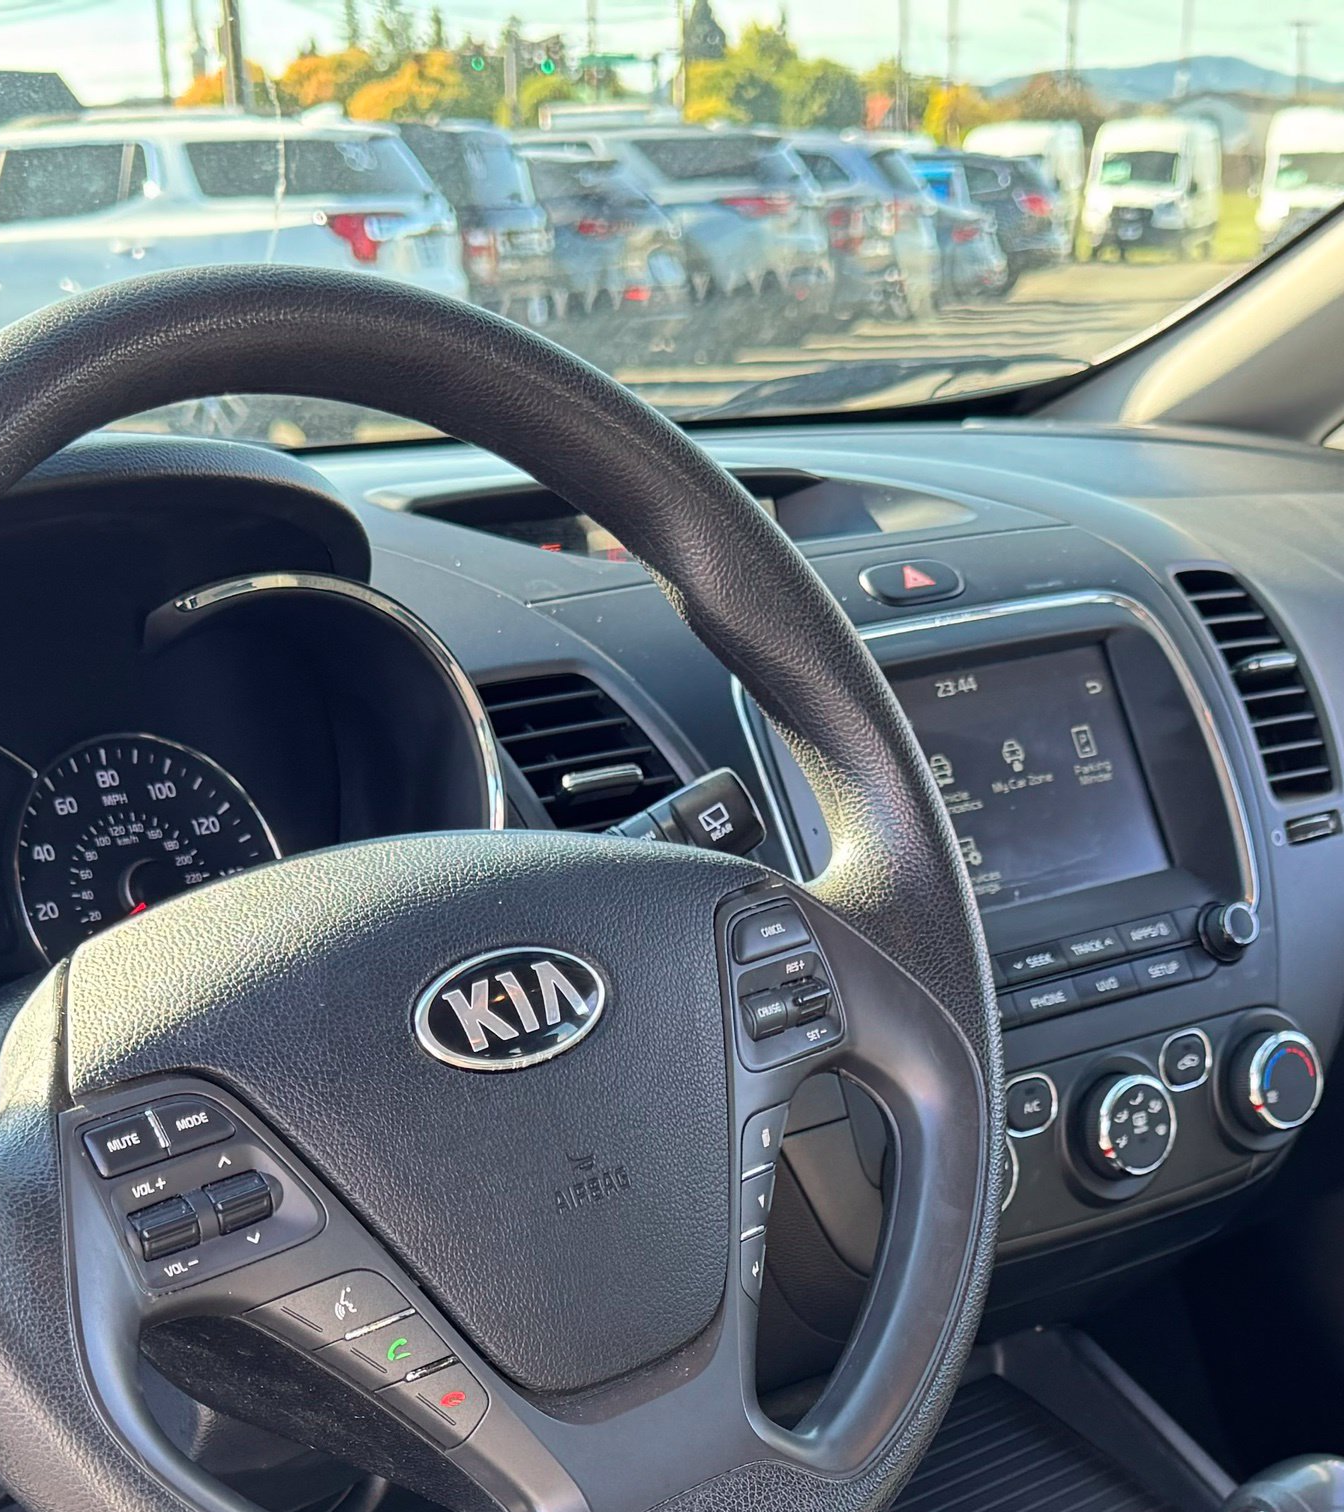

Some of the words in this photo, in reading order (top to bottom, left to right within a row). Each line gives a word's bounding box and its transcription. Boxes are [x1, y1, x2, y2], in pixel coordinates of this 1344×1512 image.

[96, 769, 120, 788] 80
[102, 793, 129, 807] MPH
[147, 782, 177, 800] 100
[54, 796, 78, 816] 60
[191, 816, 221, 836] 120
[32, 844, 56, 863] 40
[175, 855, 193, 866] 200
[35, 902, 60, 922] 20
[760, 923, 786, 938] CANCEL
[442, 960, 590, 1054] KIA
[758, 1002, 783, 1018] CRUISE
[175, 1112, 209, 1131] MODE
[107, 1132, 141, 1152] MUTE
